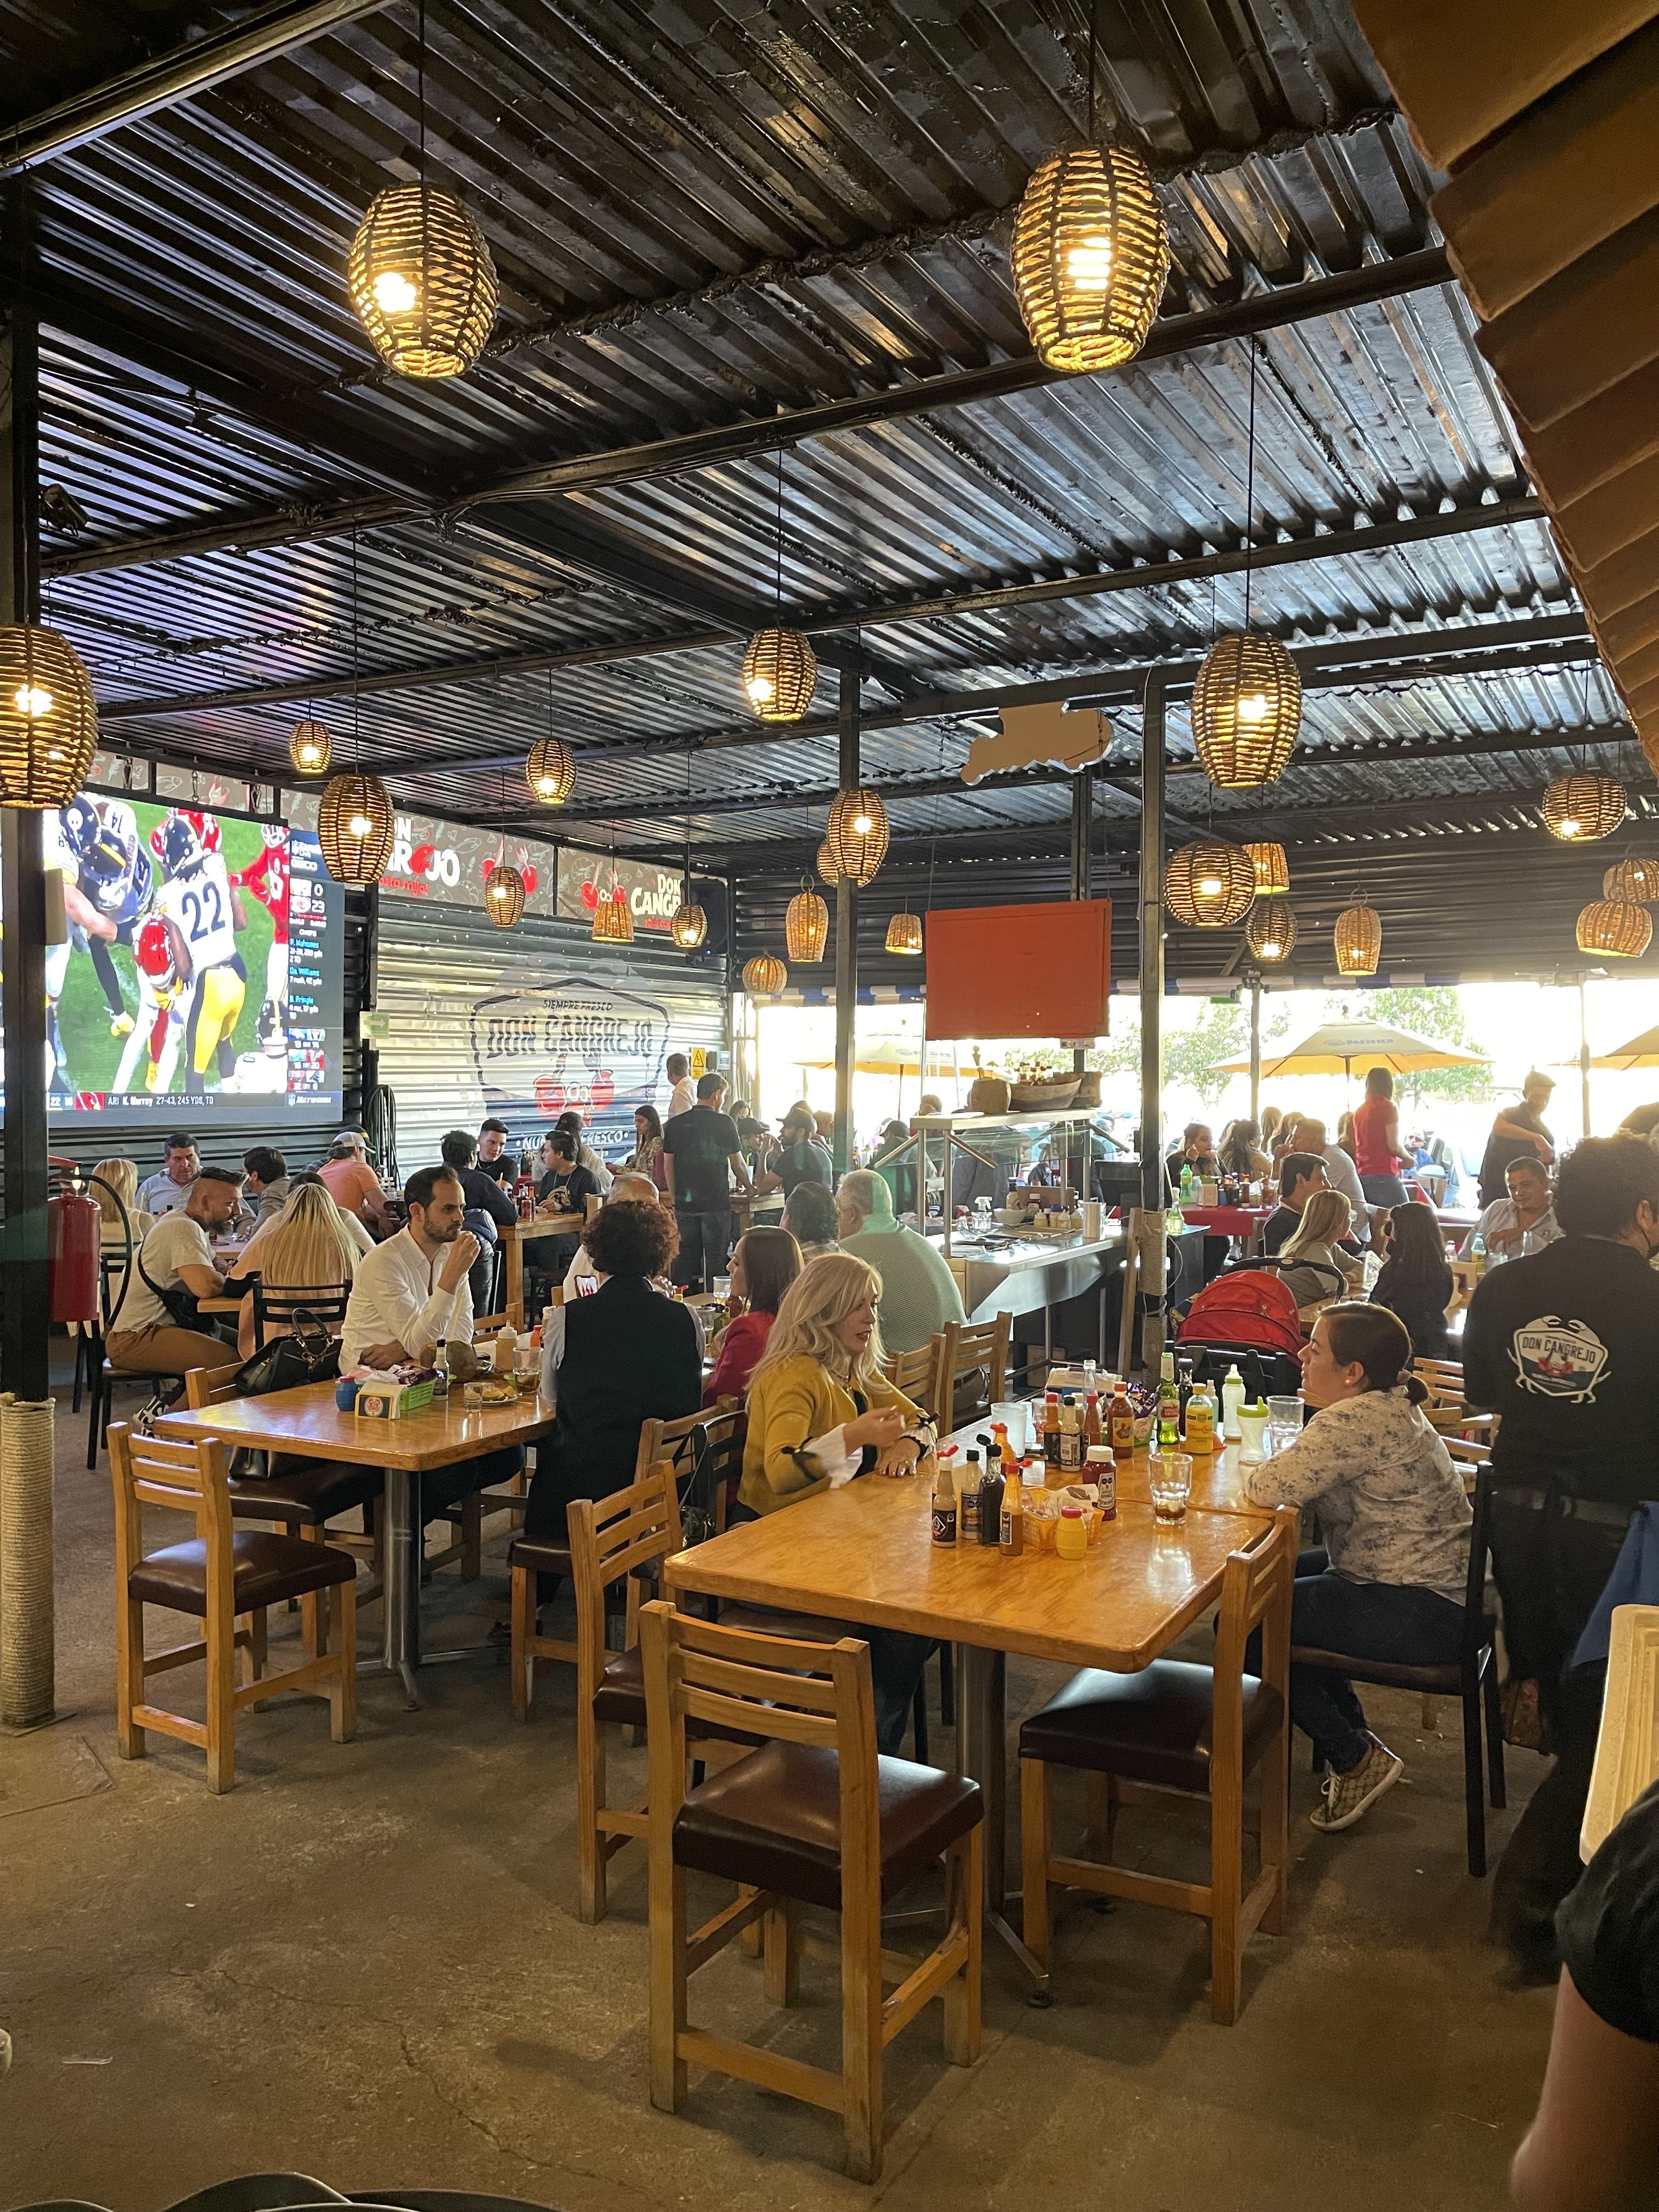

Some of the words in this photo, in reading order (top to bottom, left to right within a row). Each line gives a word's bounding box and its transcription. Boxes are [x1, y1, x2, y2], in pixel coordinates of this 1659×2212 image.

[314, 883, 324, 896] 0
[657, 873, 681, 896] DON
[182, 881, 225, 942] 22
[312, 900, 325, 913] 23
[543, 1000, 579, 1009] SIEMPRE
[580, 1001, 613, 1011] FRESCO
[487, 1015, 537, 1059] DON
[544, 1014, 653, 1057] CANGREJO
[108, 1096, 120, 1105] ARI
[130, 1096, 153, 1107] Murray
[156, 1096, 176, 1106] 27-43,
[177, 1096, 189, 1105] 245
[190, 1096, 205, 1106] YDS,
[1522, 1336, 1542, 1350] DON
[1544, 1340, 1596, 1364] CANGREJO
